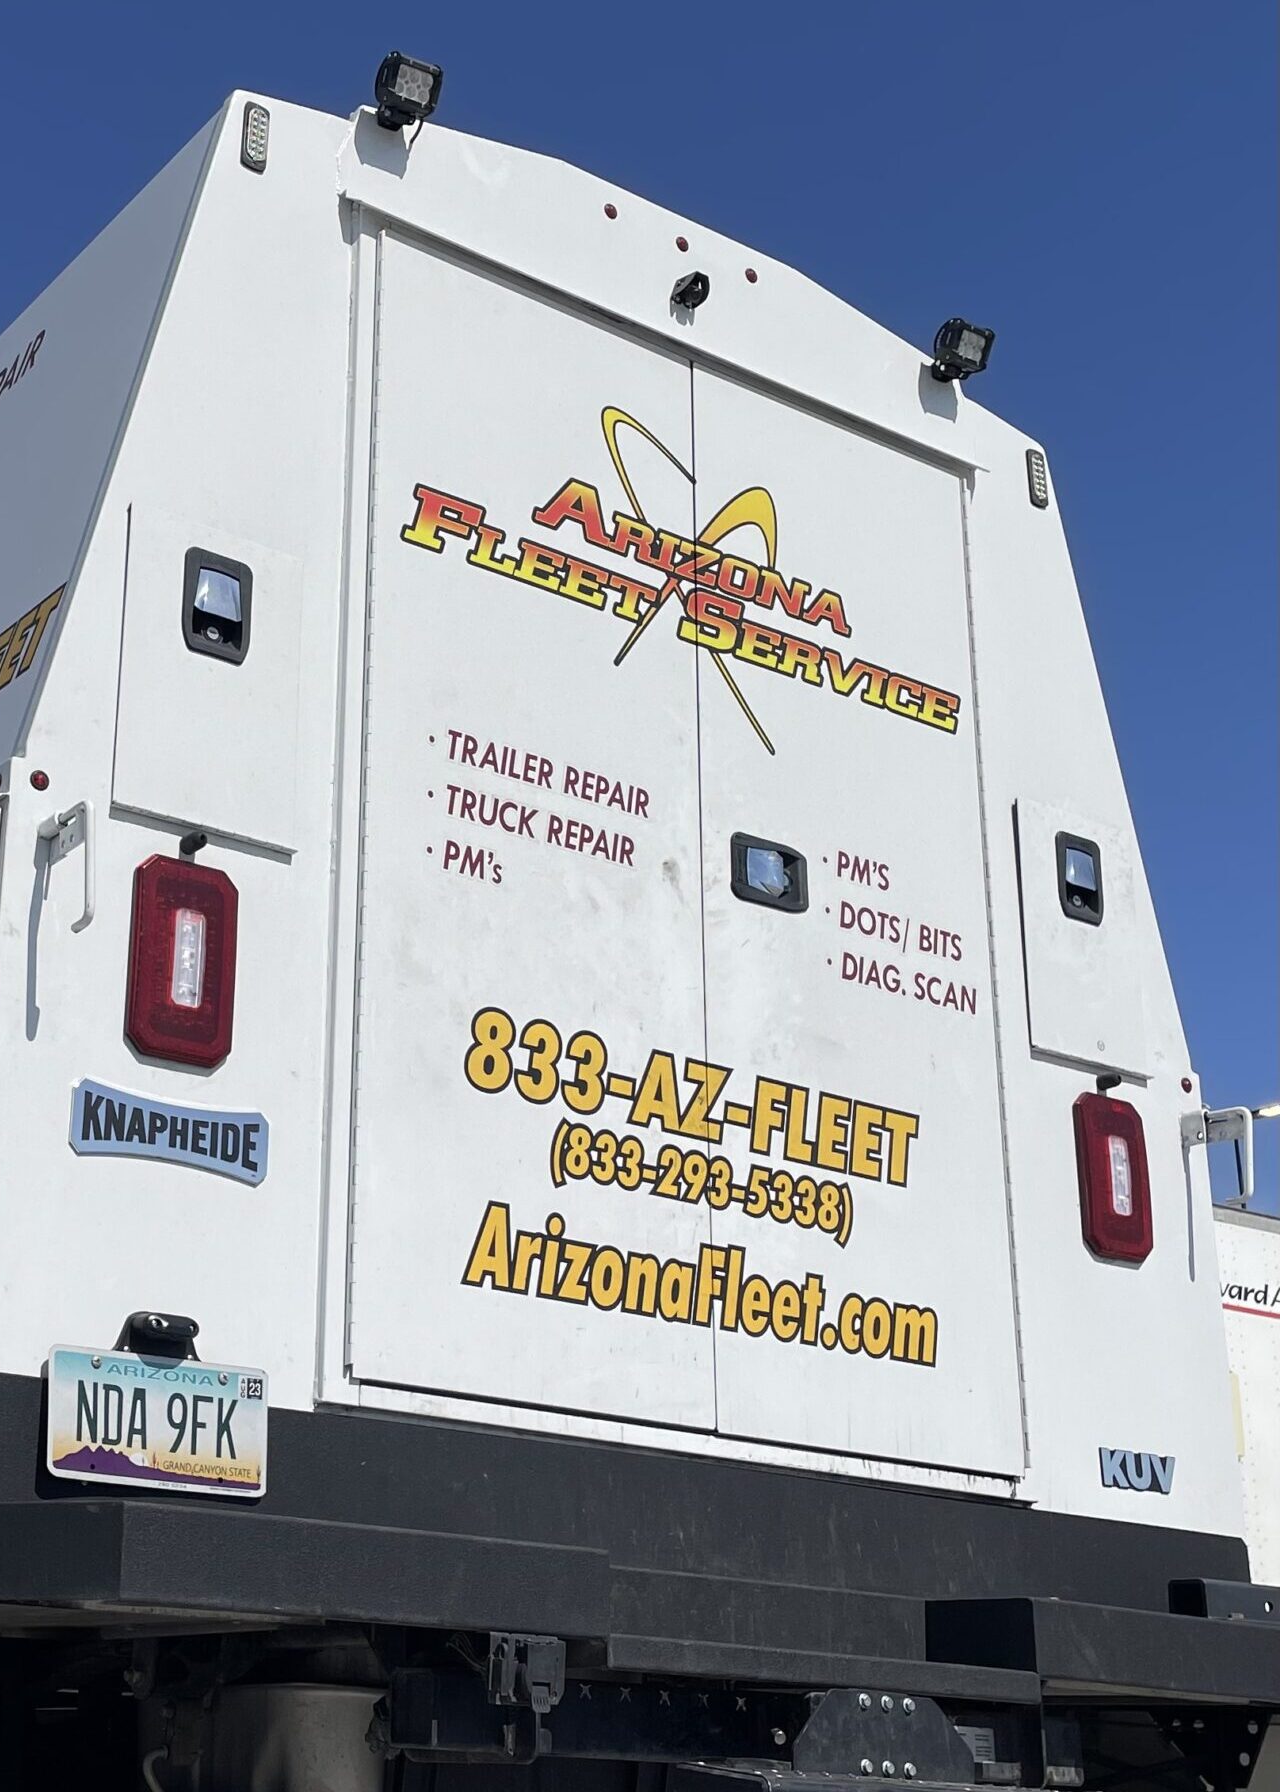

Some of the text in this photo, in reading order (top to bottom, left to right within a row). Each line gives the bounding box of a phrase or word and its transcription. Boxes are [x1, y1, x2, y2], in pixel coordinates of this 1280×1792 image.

[531, 478, 852, 638] ARIZONA
[400, 482, 961, 735] FLEET SERVICE
[447, 729, 651, 819] TRAILER REPAIR
[443, 840, 503, 885] PM's
[446, 784, 636, 867] TRUCK REPAIR
[837, 851, 890, 891] PM'S
[920, 923, 963, 962] BITS
[841, 951, 977, 1016] DIAG. SCAN
[81, 1090, 261, 1173] KNAPHEIDE
[464, 1006, 919, 1187] 833-AZ-FLEET
[551, 1118, 853, 1247] (833-293-5338)
[461, 1200, 937, 1367] ArizonaFleet.com
[107, 1363, 213, 1387] ARIZONA
[249, 1382, 261, 1396] 23
[76, 1379, 238, 1460] NDA 9FK
[163, 1460, 251, 1479] GRAND CANYON STATE
[1098, 1446, 1176, 1495] KUV
